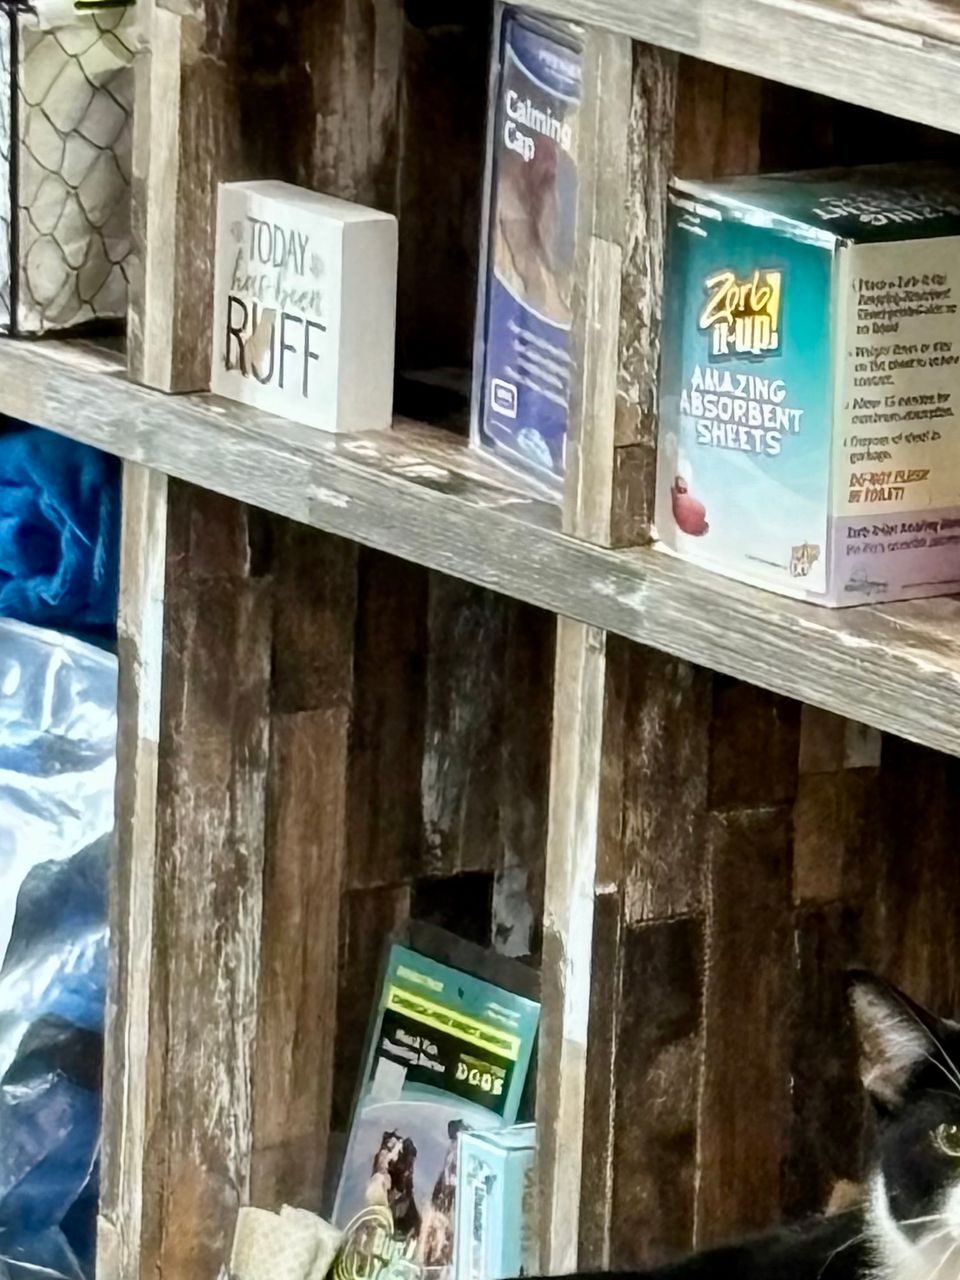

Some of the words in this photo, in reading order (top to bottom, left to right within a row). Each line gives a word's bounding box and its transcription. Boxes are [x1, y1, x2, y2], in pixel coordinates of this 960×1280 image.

[504, 119, 536, 163] Cap
[506, 89, 572, 152] Calming
[247, 215, 309, 276] TODAY
[224, 294, 327, 398] RUFF
[691, 364, 786, 404] AMAZING
[679, 388, 804, 434] ABSORBENT
[697, 419, 782, 456] SHEETS
